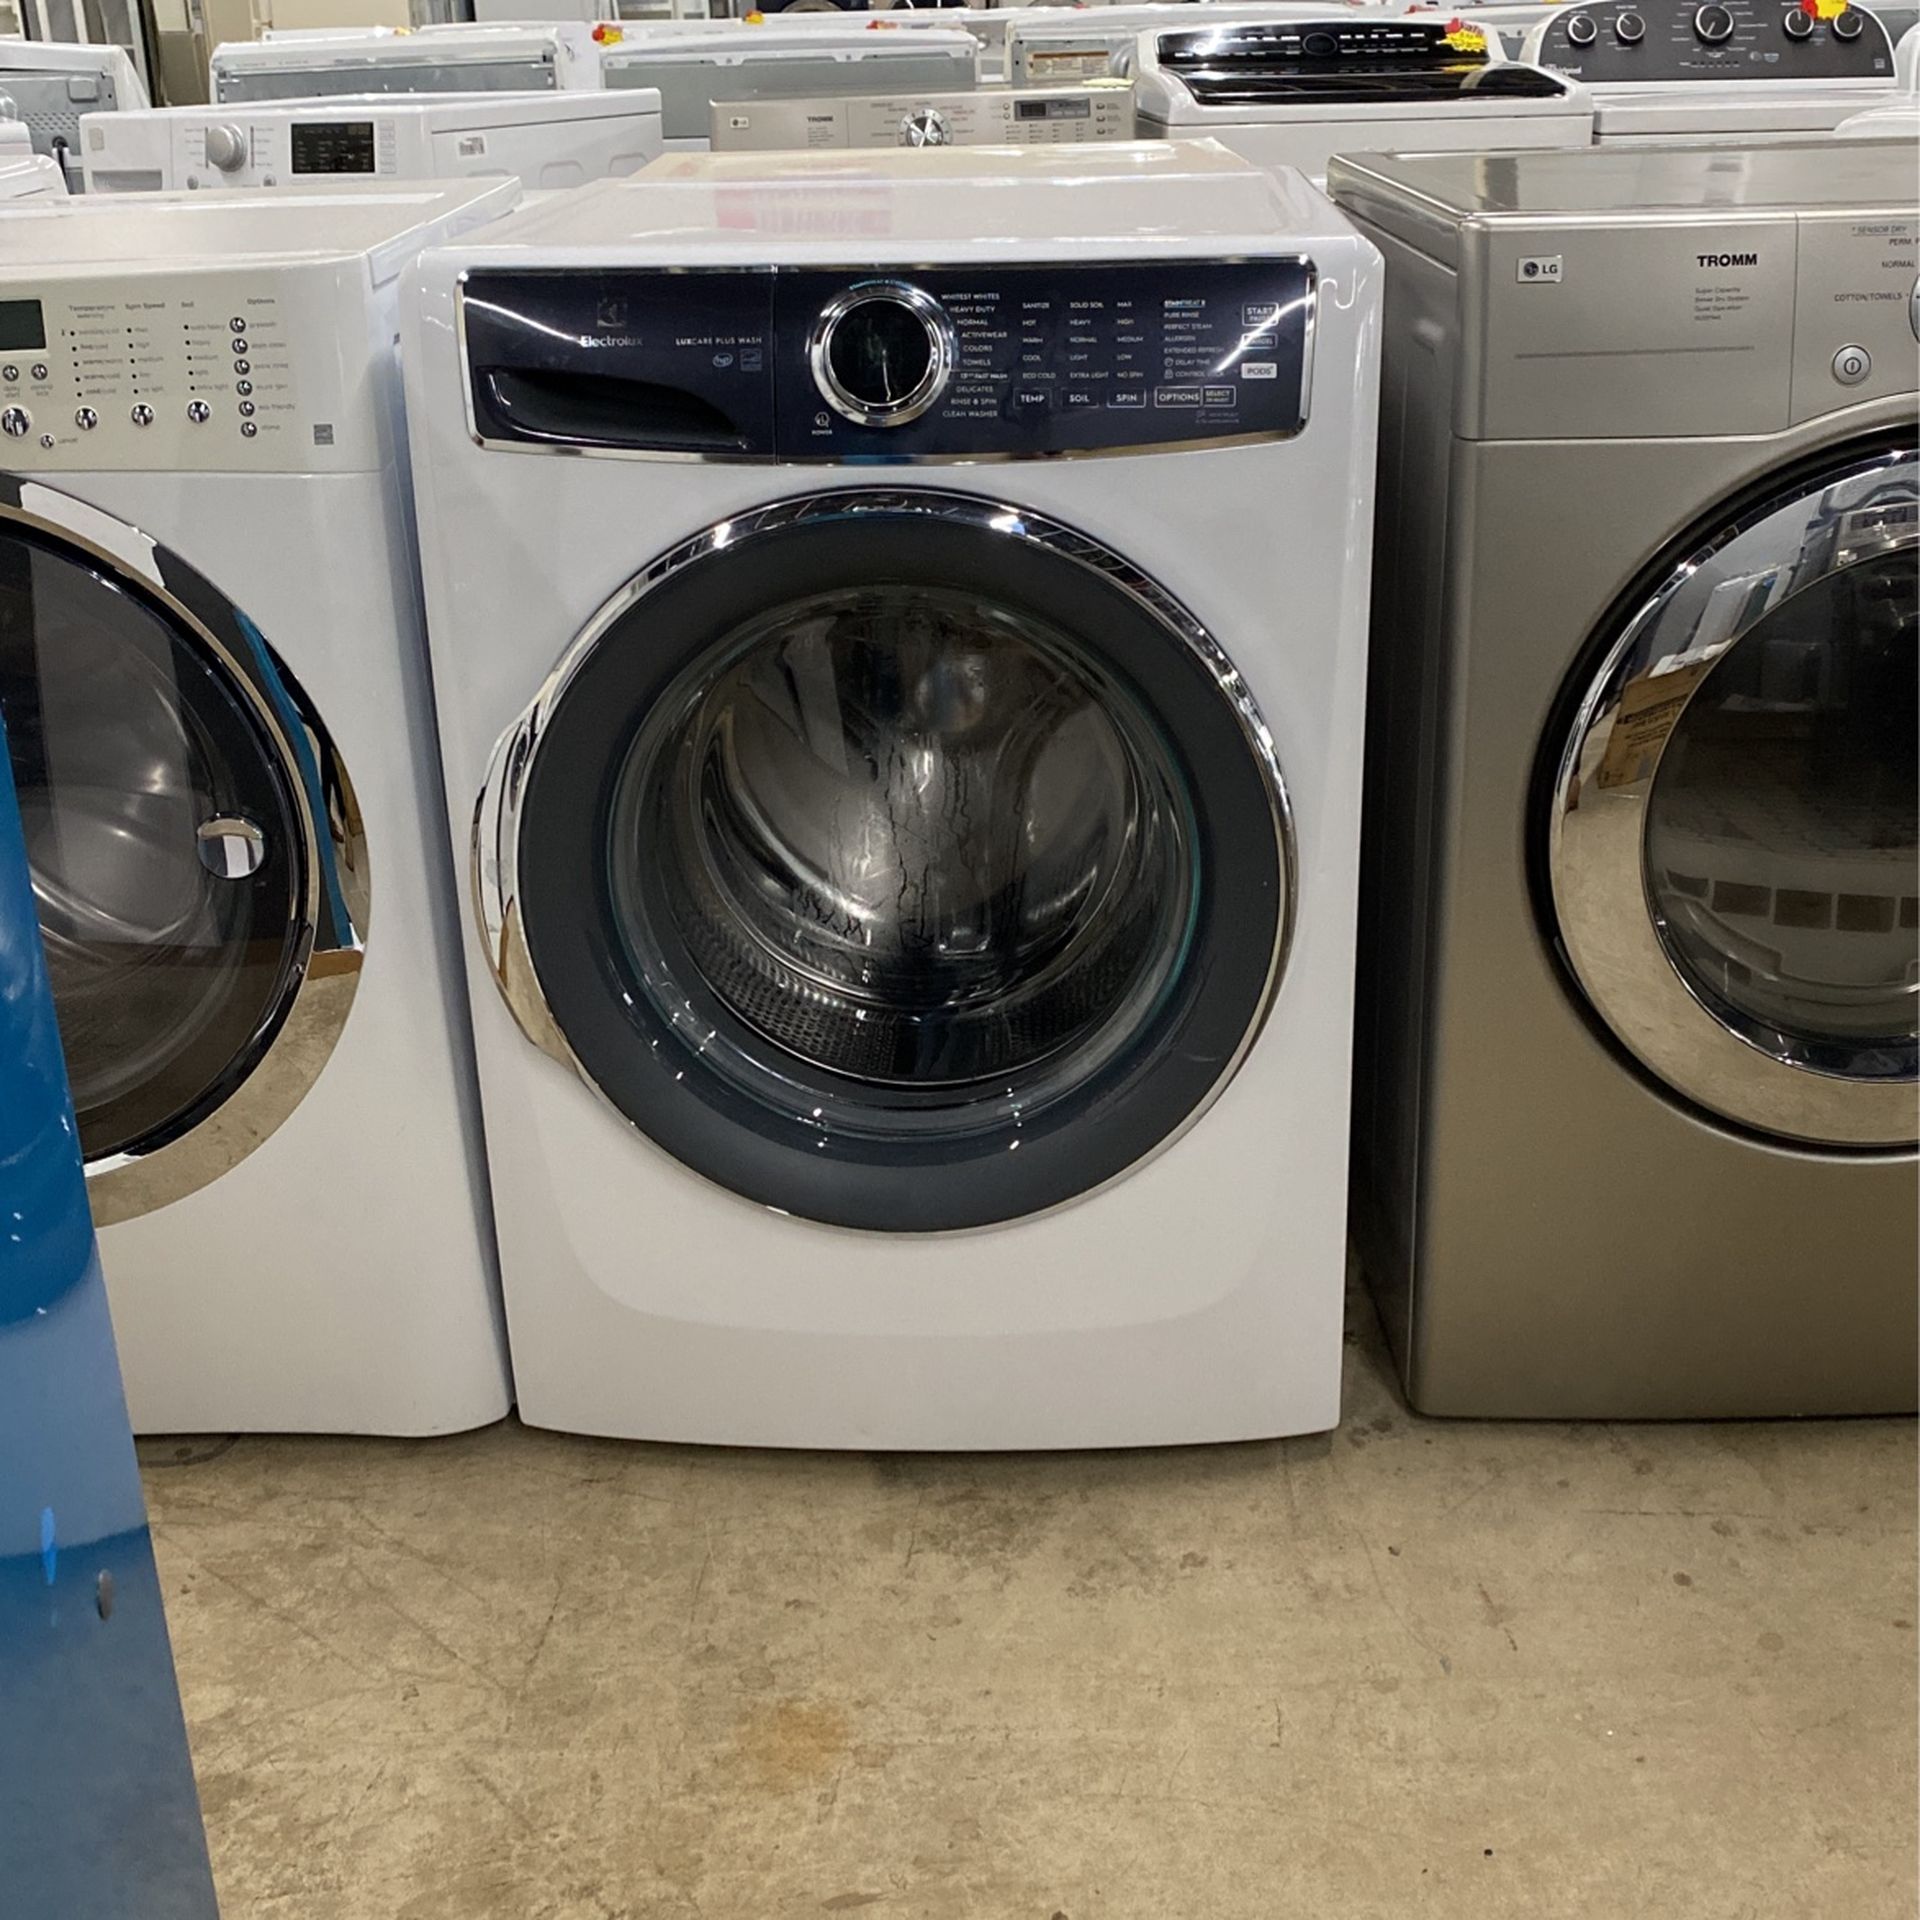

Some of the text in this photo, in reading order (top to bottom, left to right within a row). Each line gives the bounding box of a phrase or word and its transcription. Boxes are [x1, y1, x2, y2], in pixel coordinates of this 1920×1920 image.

[1697, 254, 1758, 267] TROMM
[1542, 265, 1558, 274] LG
[1834, 293, 1903, 302] COTTON/TOWELS
[1246, 307, 1274, 316] START
[580, 335, 643, 347] Electrolux
[675, 337, 762, 346] LUXCARE PLUS WASH
[1247, 367, 1272, 375] PODS
[1020, 395, 1045, 403] TEMP
[1069, 395, 1090, 403] SOIL
[1116, 394, 1137, 402] SPIN
[1159, 393, 1200, 401] OPTIONS
